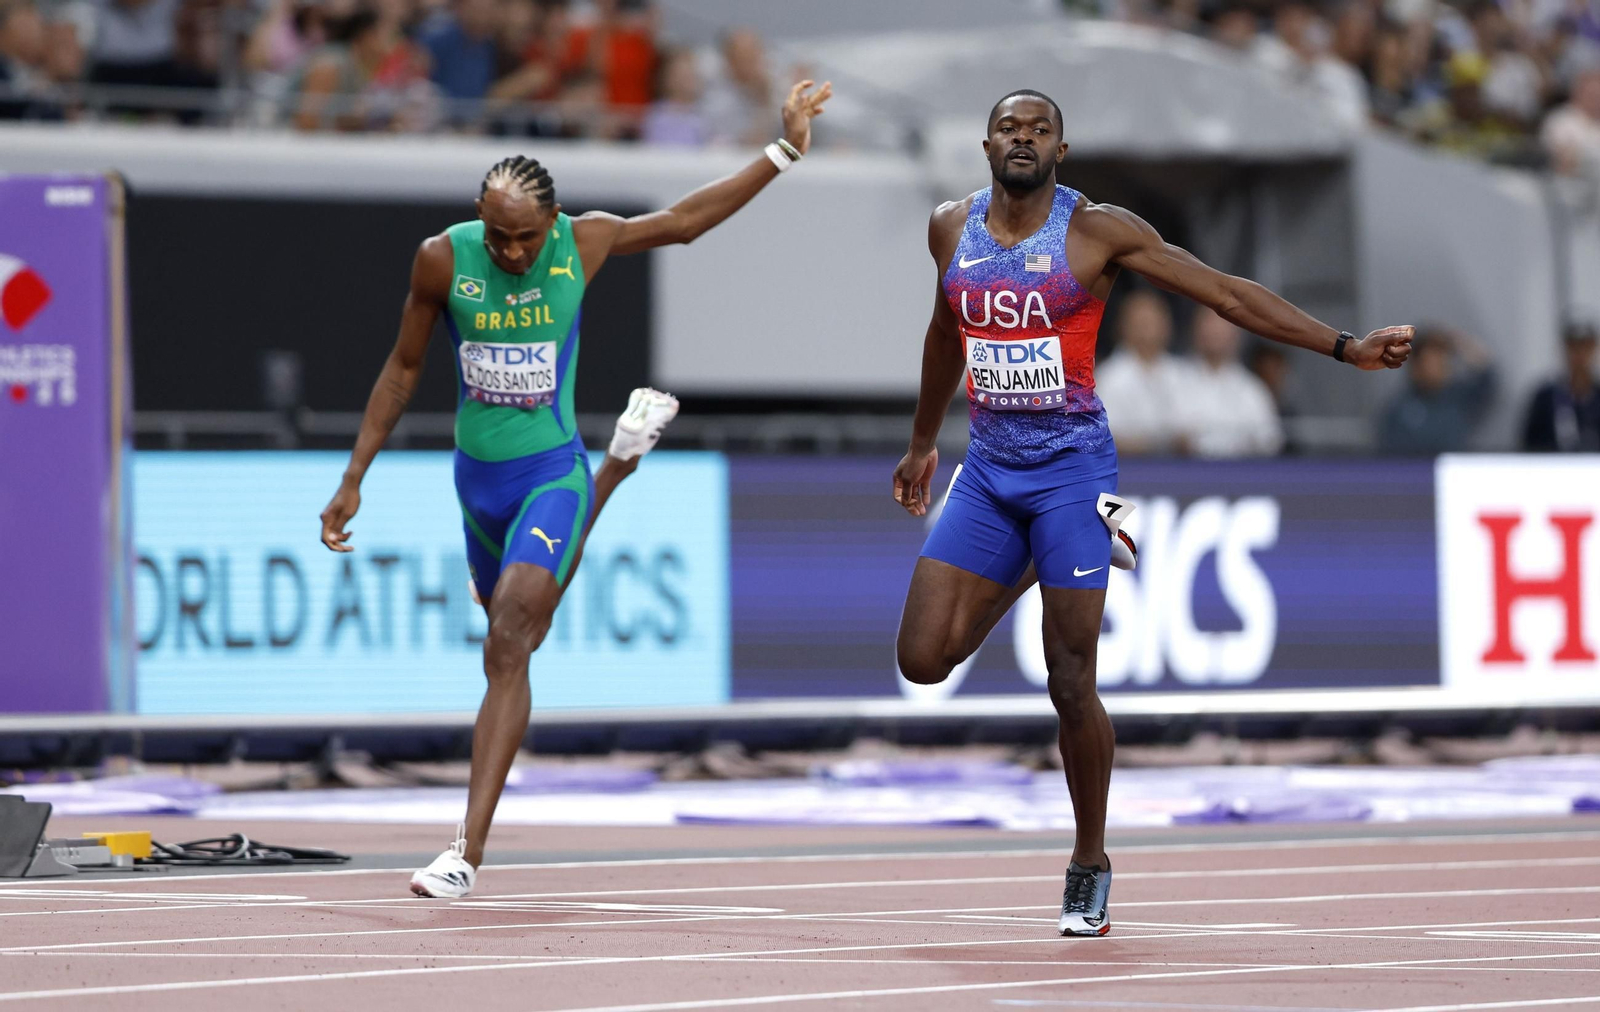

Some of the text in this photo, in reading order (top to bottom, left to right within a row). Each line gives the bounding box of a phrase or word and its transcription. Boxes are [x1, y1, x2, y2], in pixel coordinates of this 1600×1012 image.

[475, 304, 555, 330] BRASIL
[961, 290, 1053, 329] USA
[483, 345, 548, 365] TDK
[986, 341, 1054, 364] TDK
[503, 369, 553, 390] SANTOS
[972, 366, 1060, 391] BENJAMIN
[990, 394, 1063, 407] TOKYO 25
[1104, 501, 1123, 518] 7
[1475, 510, 1598, 665] H
